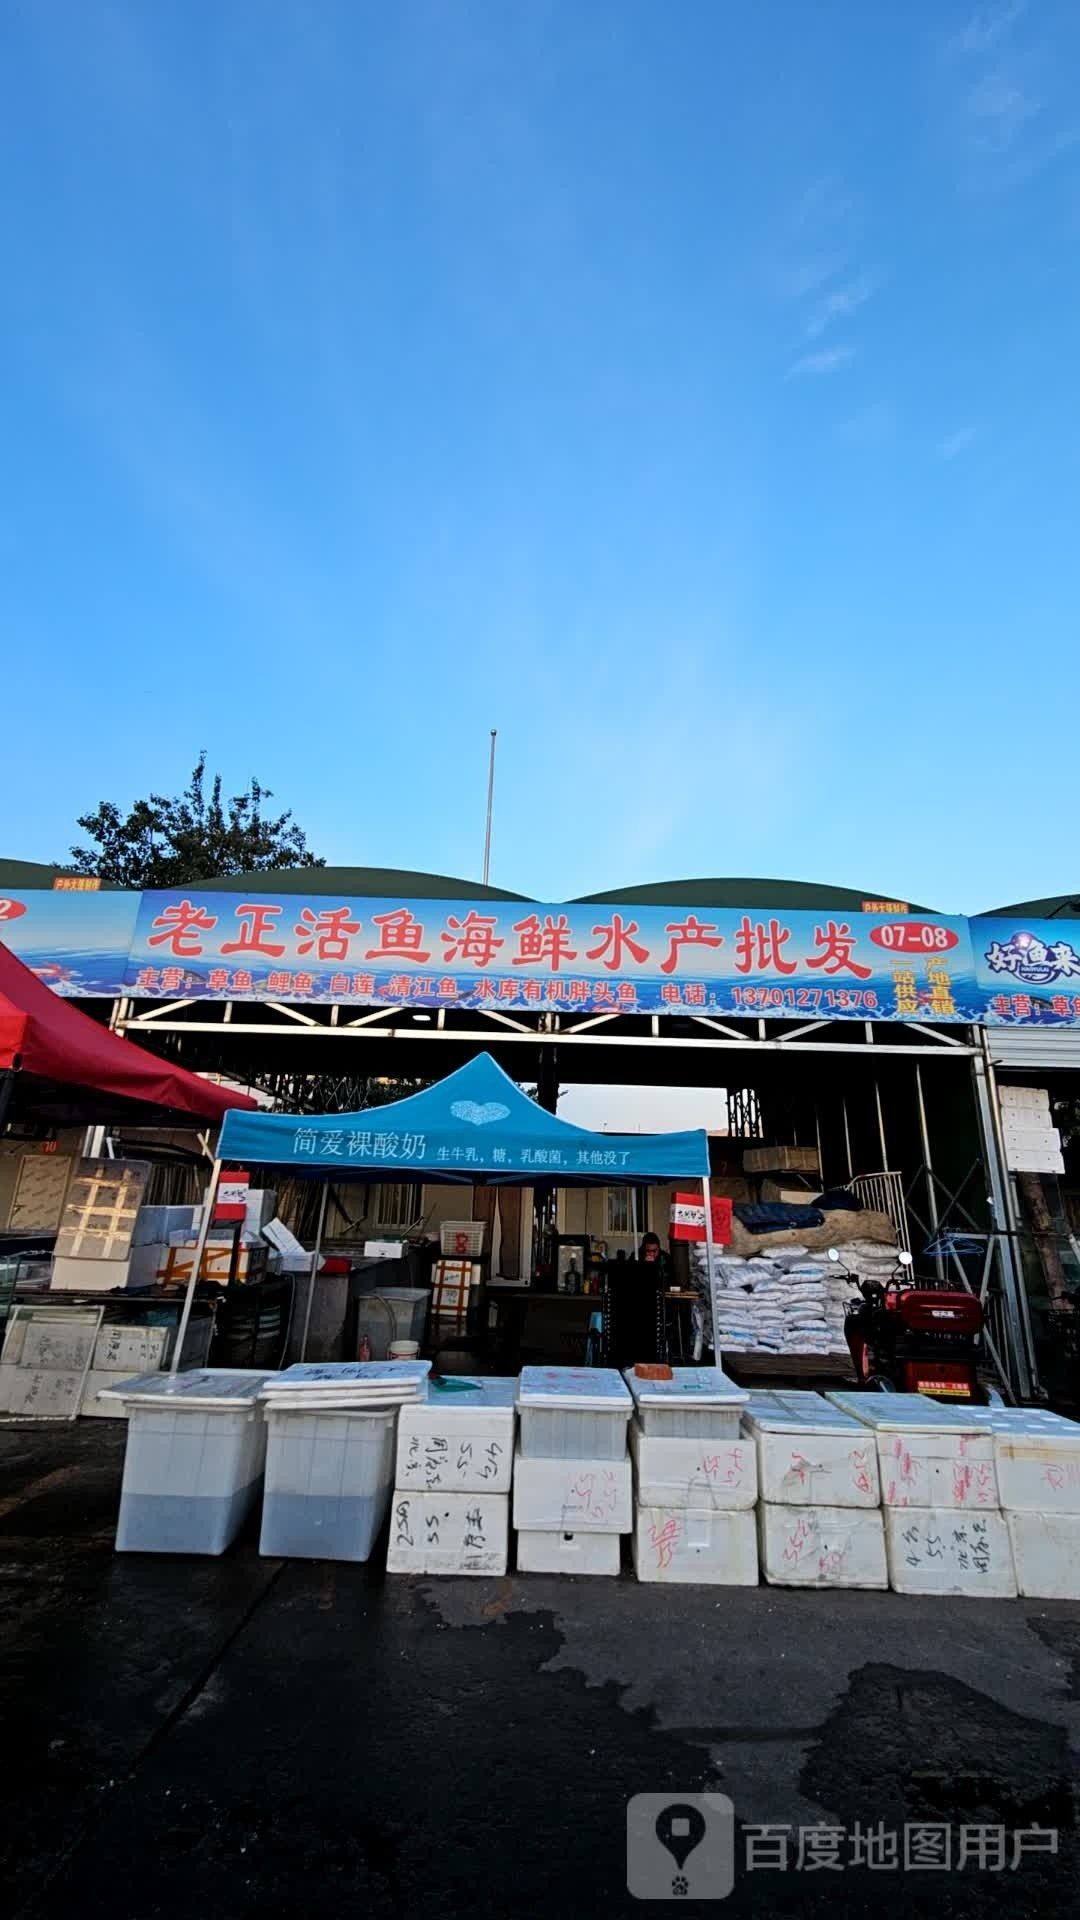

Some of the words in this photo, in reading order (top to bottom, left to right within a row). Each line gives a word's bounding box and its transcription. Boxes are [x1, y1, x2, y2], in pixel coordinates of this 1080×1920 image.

[147, 899, 873, 979] 老正活鱼海鲜水产批发
[881, 926, 948, 948] 07-08
[208, 970, 254, 991] 草鱼
[267, 971, 313, 993] 鲤鱼
[330, 973, 374, 995] 白莲
[389, 975, 459, 999] 清江鱼
[473, 979, 638, 1003] 水库有机胖头鱼
[731, 987, 878, 1008] 13701271376
[889, 959, 919, 1013] 一站供应
[925, 957, 955, 1014] 产地直销
[293, 1127, 427, 1160] 简爱裸酸奶
